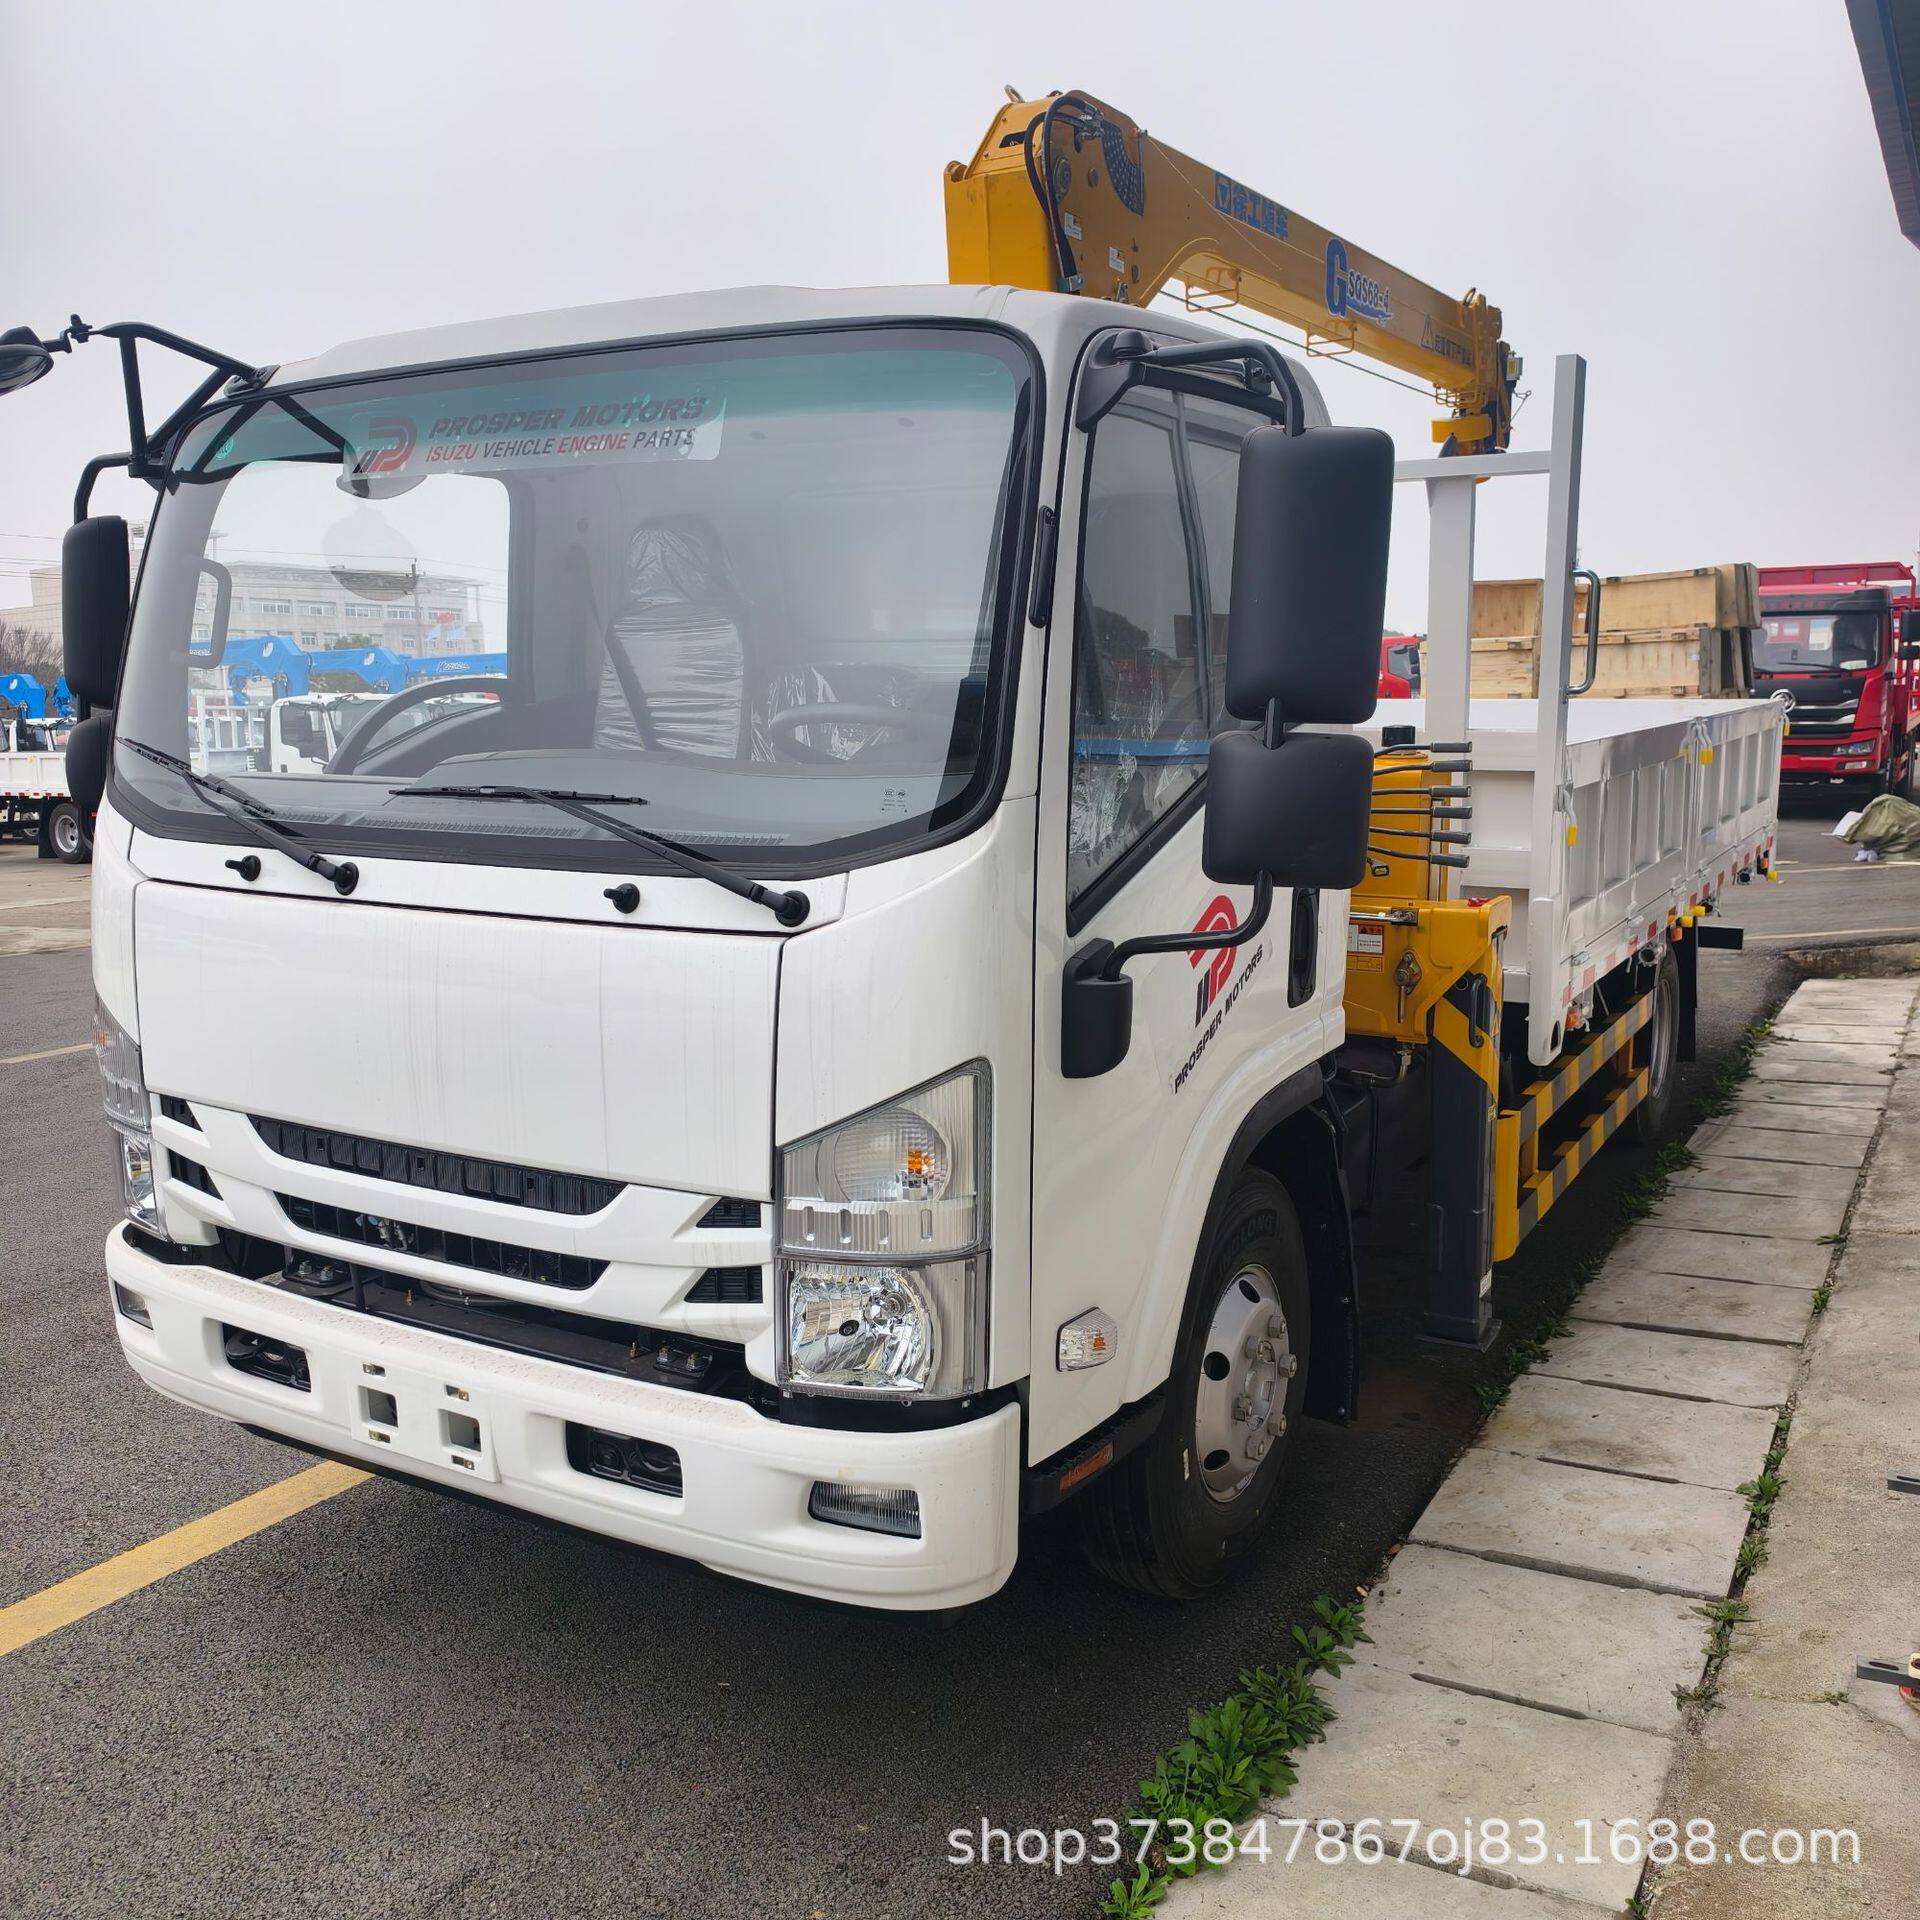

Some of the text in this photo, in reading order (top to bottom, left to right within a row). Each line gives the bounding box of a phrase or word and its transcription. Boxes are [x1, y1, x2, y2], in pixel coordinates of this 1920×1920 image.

[428, 396, 709, 439] PROSPER MOTORS
[425, 428, 696, 463] ISUZU VEHICLE ENGINE PARTS
[1174, 944, 1263, 1095] PROSPER MOTORS
